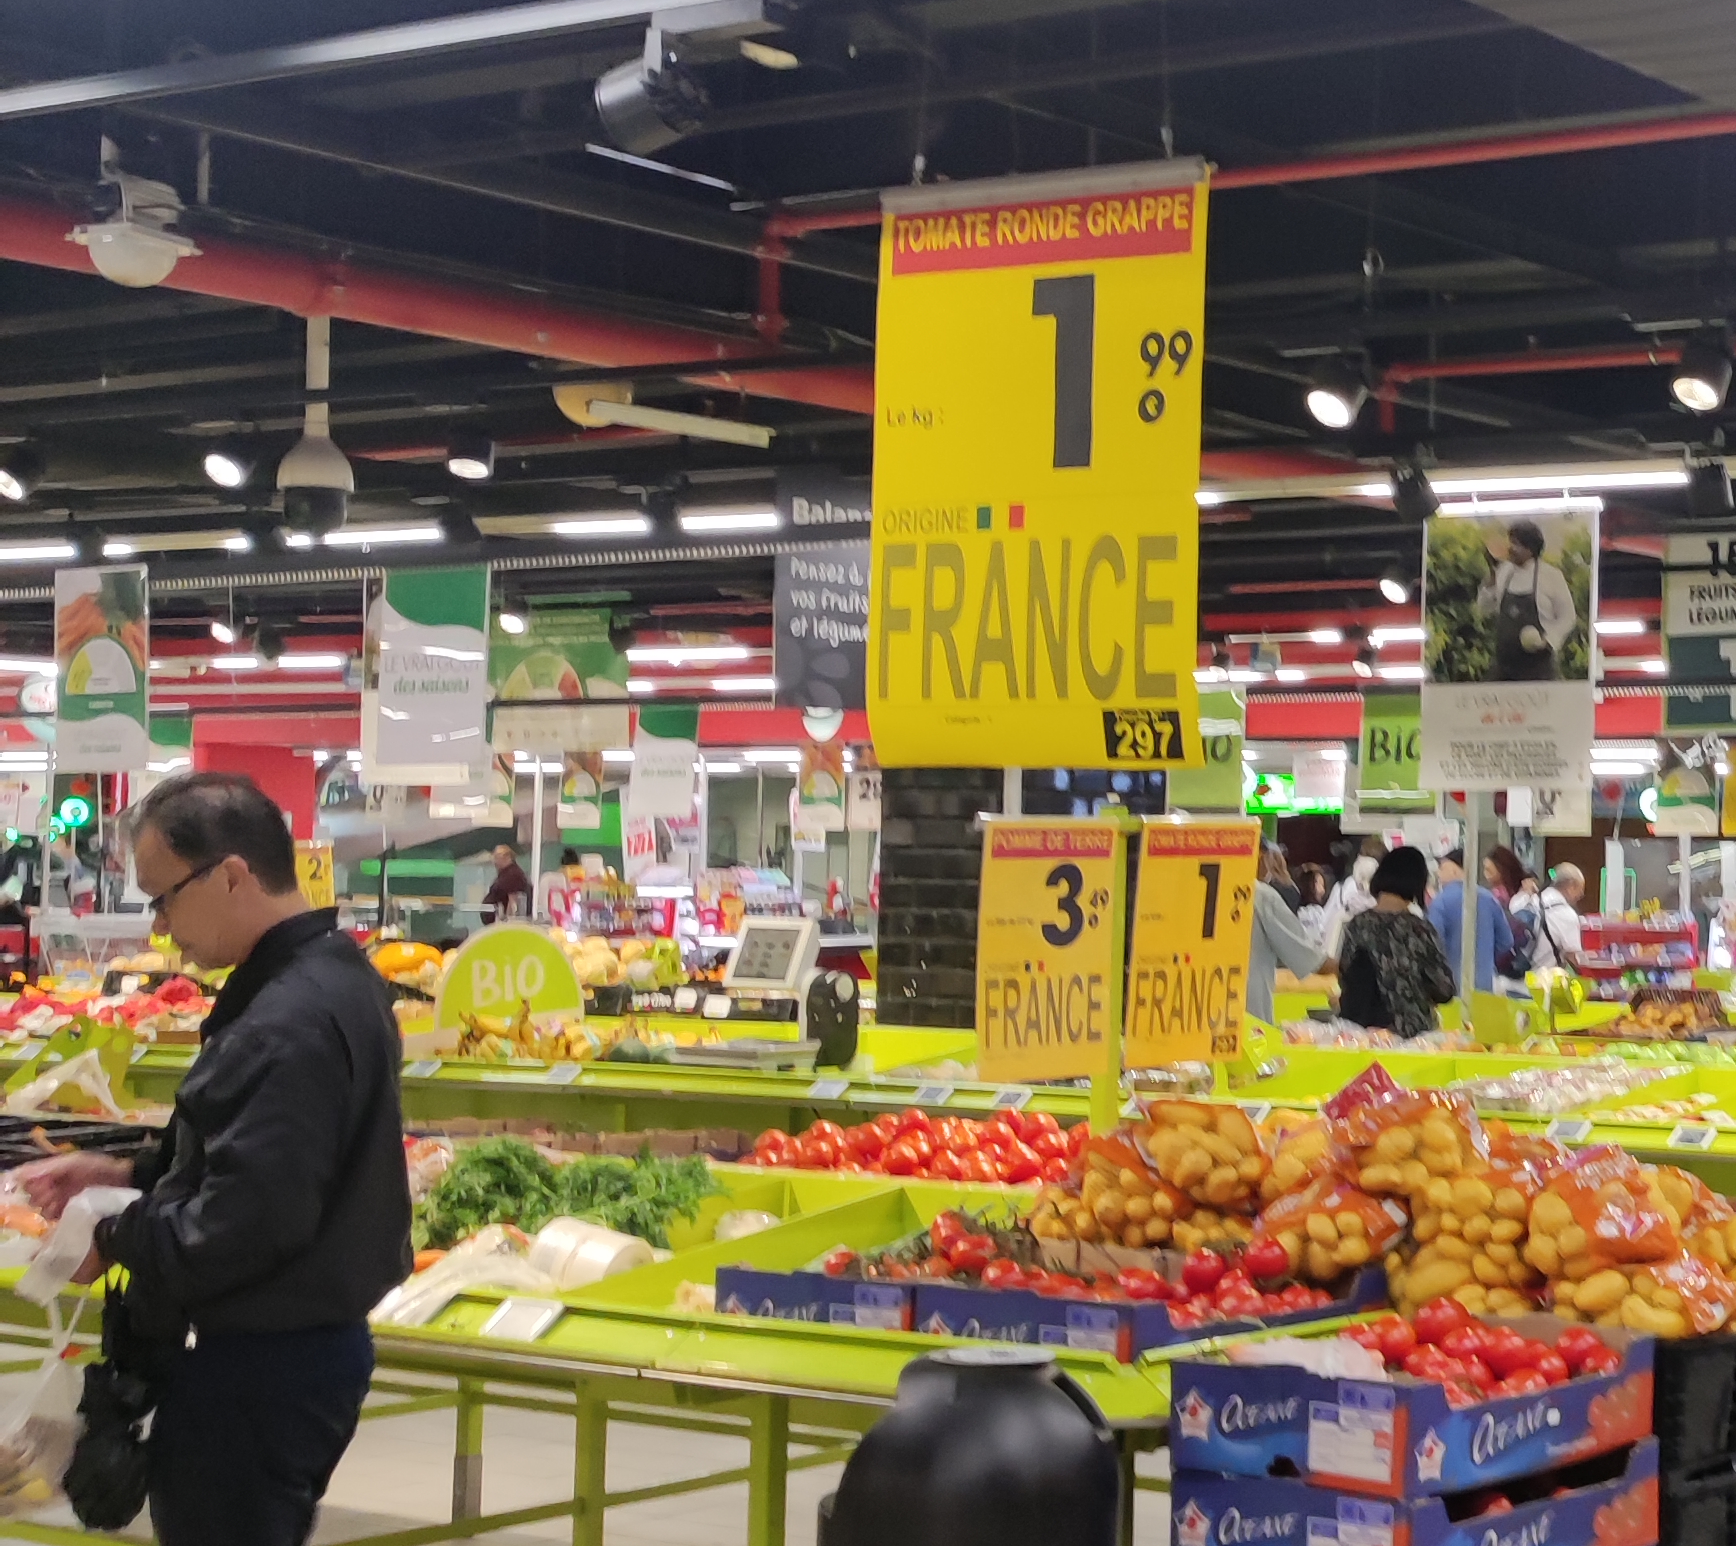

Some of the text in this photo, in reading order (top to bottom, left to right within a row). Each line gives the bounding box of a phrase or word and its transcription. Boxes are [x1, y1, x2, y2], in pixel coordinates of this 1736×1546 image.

[897, 192, 1191, 254] TOMATE RONDE GRAPPE
[1031, 274, 1194, 470] 1 99
[886, 404, 934, 430] Le kg
[881, 506, 970, 536] ORIGINE
[790, 556, 846, 585] Pensez
[790, 588, 817, 611] vos
[878, 533, 1179, 702] FRANCE
[790, 614, 870, 648] et légum
[1112, 719, 1176, 762] 297
[1048, 829, 1067, 851] DE
[1041, 862, 1085, 948] 3
[1198, 862, 1222, 940] 1
[984, 973, 1104, 1050] FRANCE
[1131, 966, 1242, 1038] FRANCE
